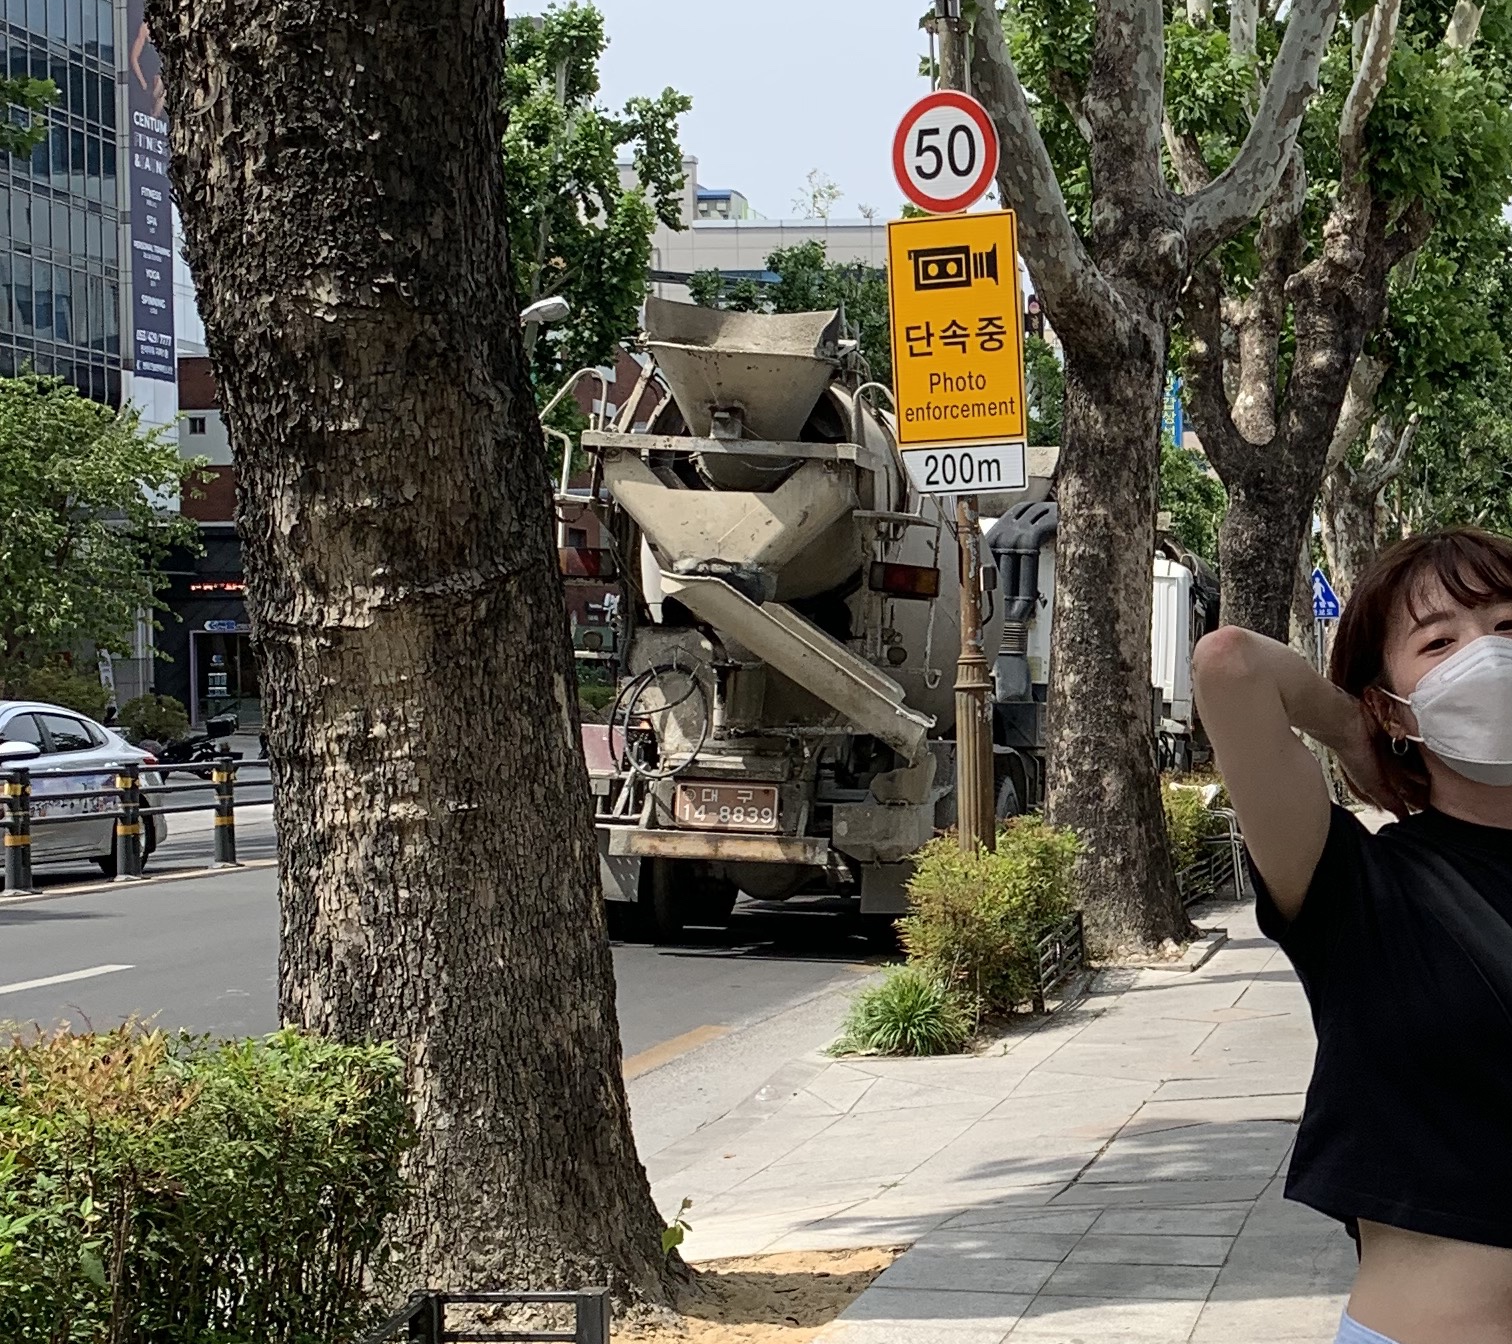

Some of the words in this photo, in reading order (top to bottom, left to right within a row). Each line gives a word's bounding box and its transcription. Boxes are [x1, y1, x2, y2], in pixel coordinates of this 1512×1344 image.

[133, 110, 168, 136] CENTUM
[914, 123, 977, 181] 50
[905, 315, 1008, 358] 단속중
[928, 371, 988, 394] Photo
[904, 396, 1016, 423] enforcement
[924, 454, 1002, 487] 200m
[701, 788, 754, 804] 대구
[683, 804, 773, 824] 14-8839
